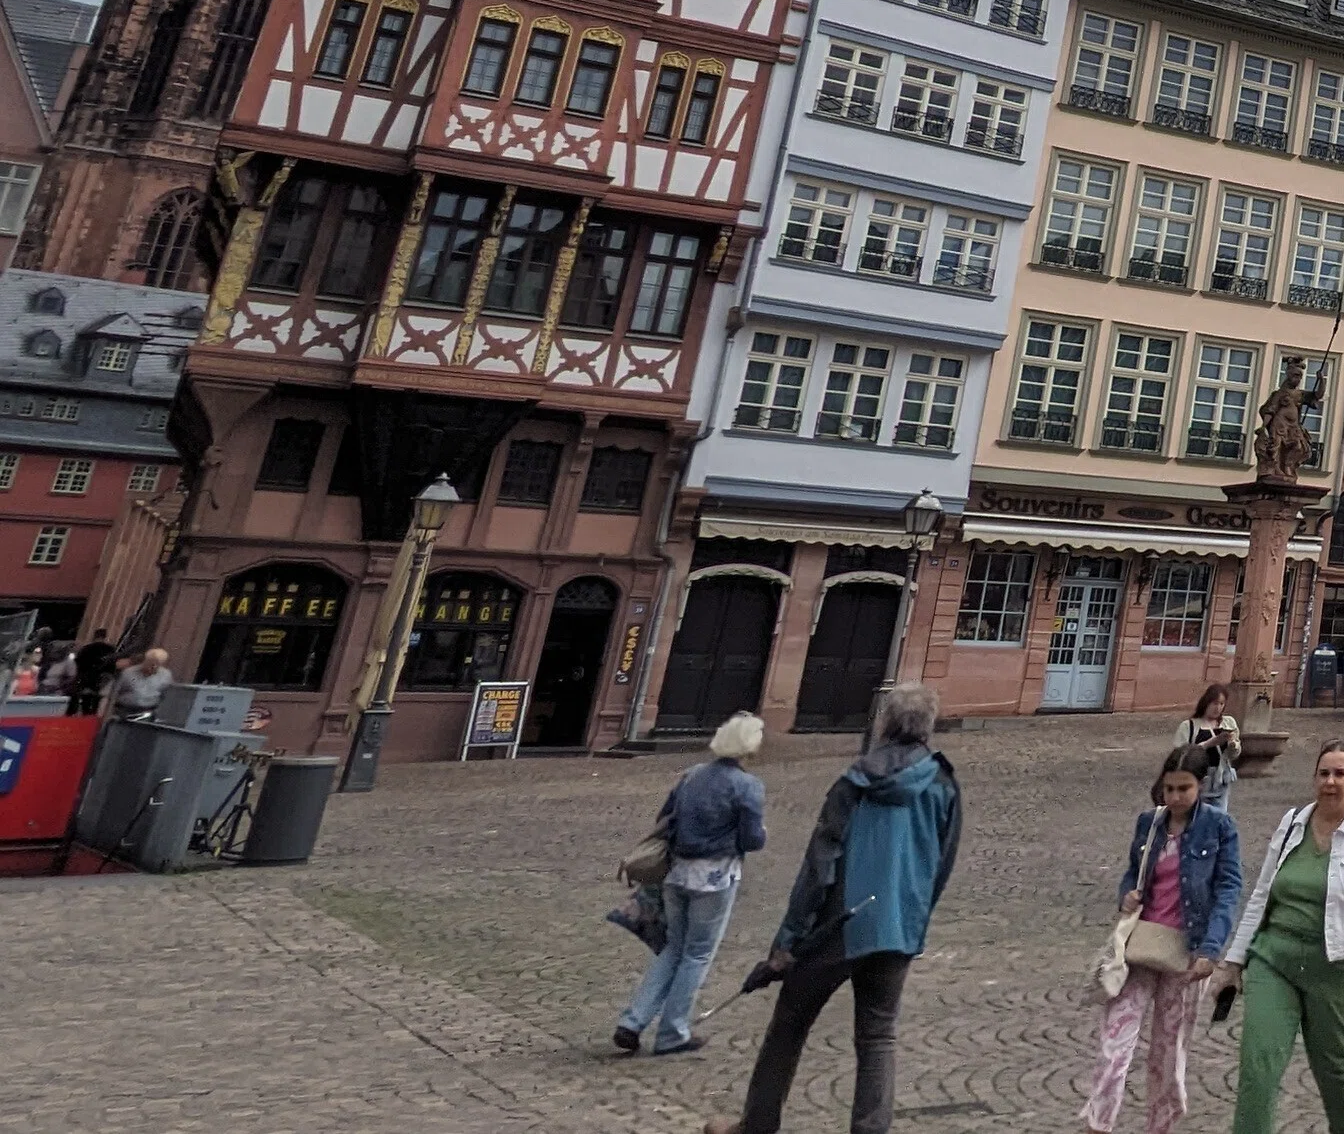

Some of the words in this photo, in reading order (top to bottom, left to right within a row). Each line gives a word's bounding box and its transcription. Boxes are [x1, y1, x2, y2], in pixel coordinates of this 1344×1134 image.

[978, 489, 1106, 519] Souvenirs
[219, 597, 337, 617] KAFFEE
[415, 603, 513, 622] HANGE
